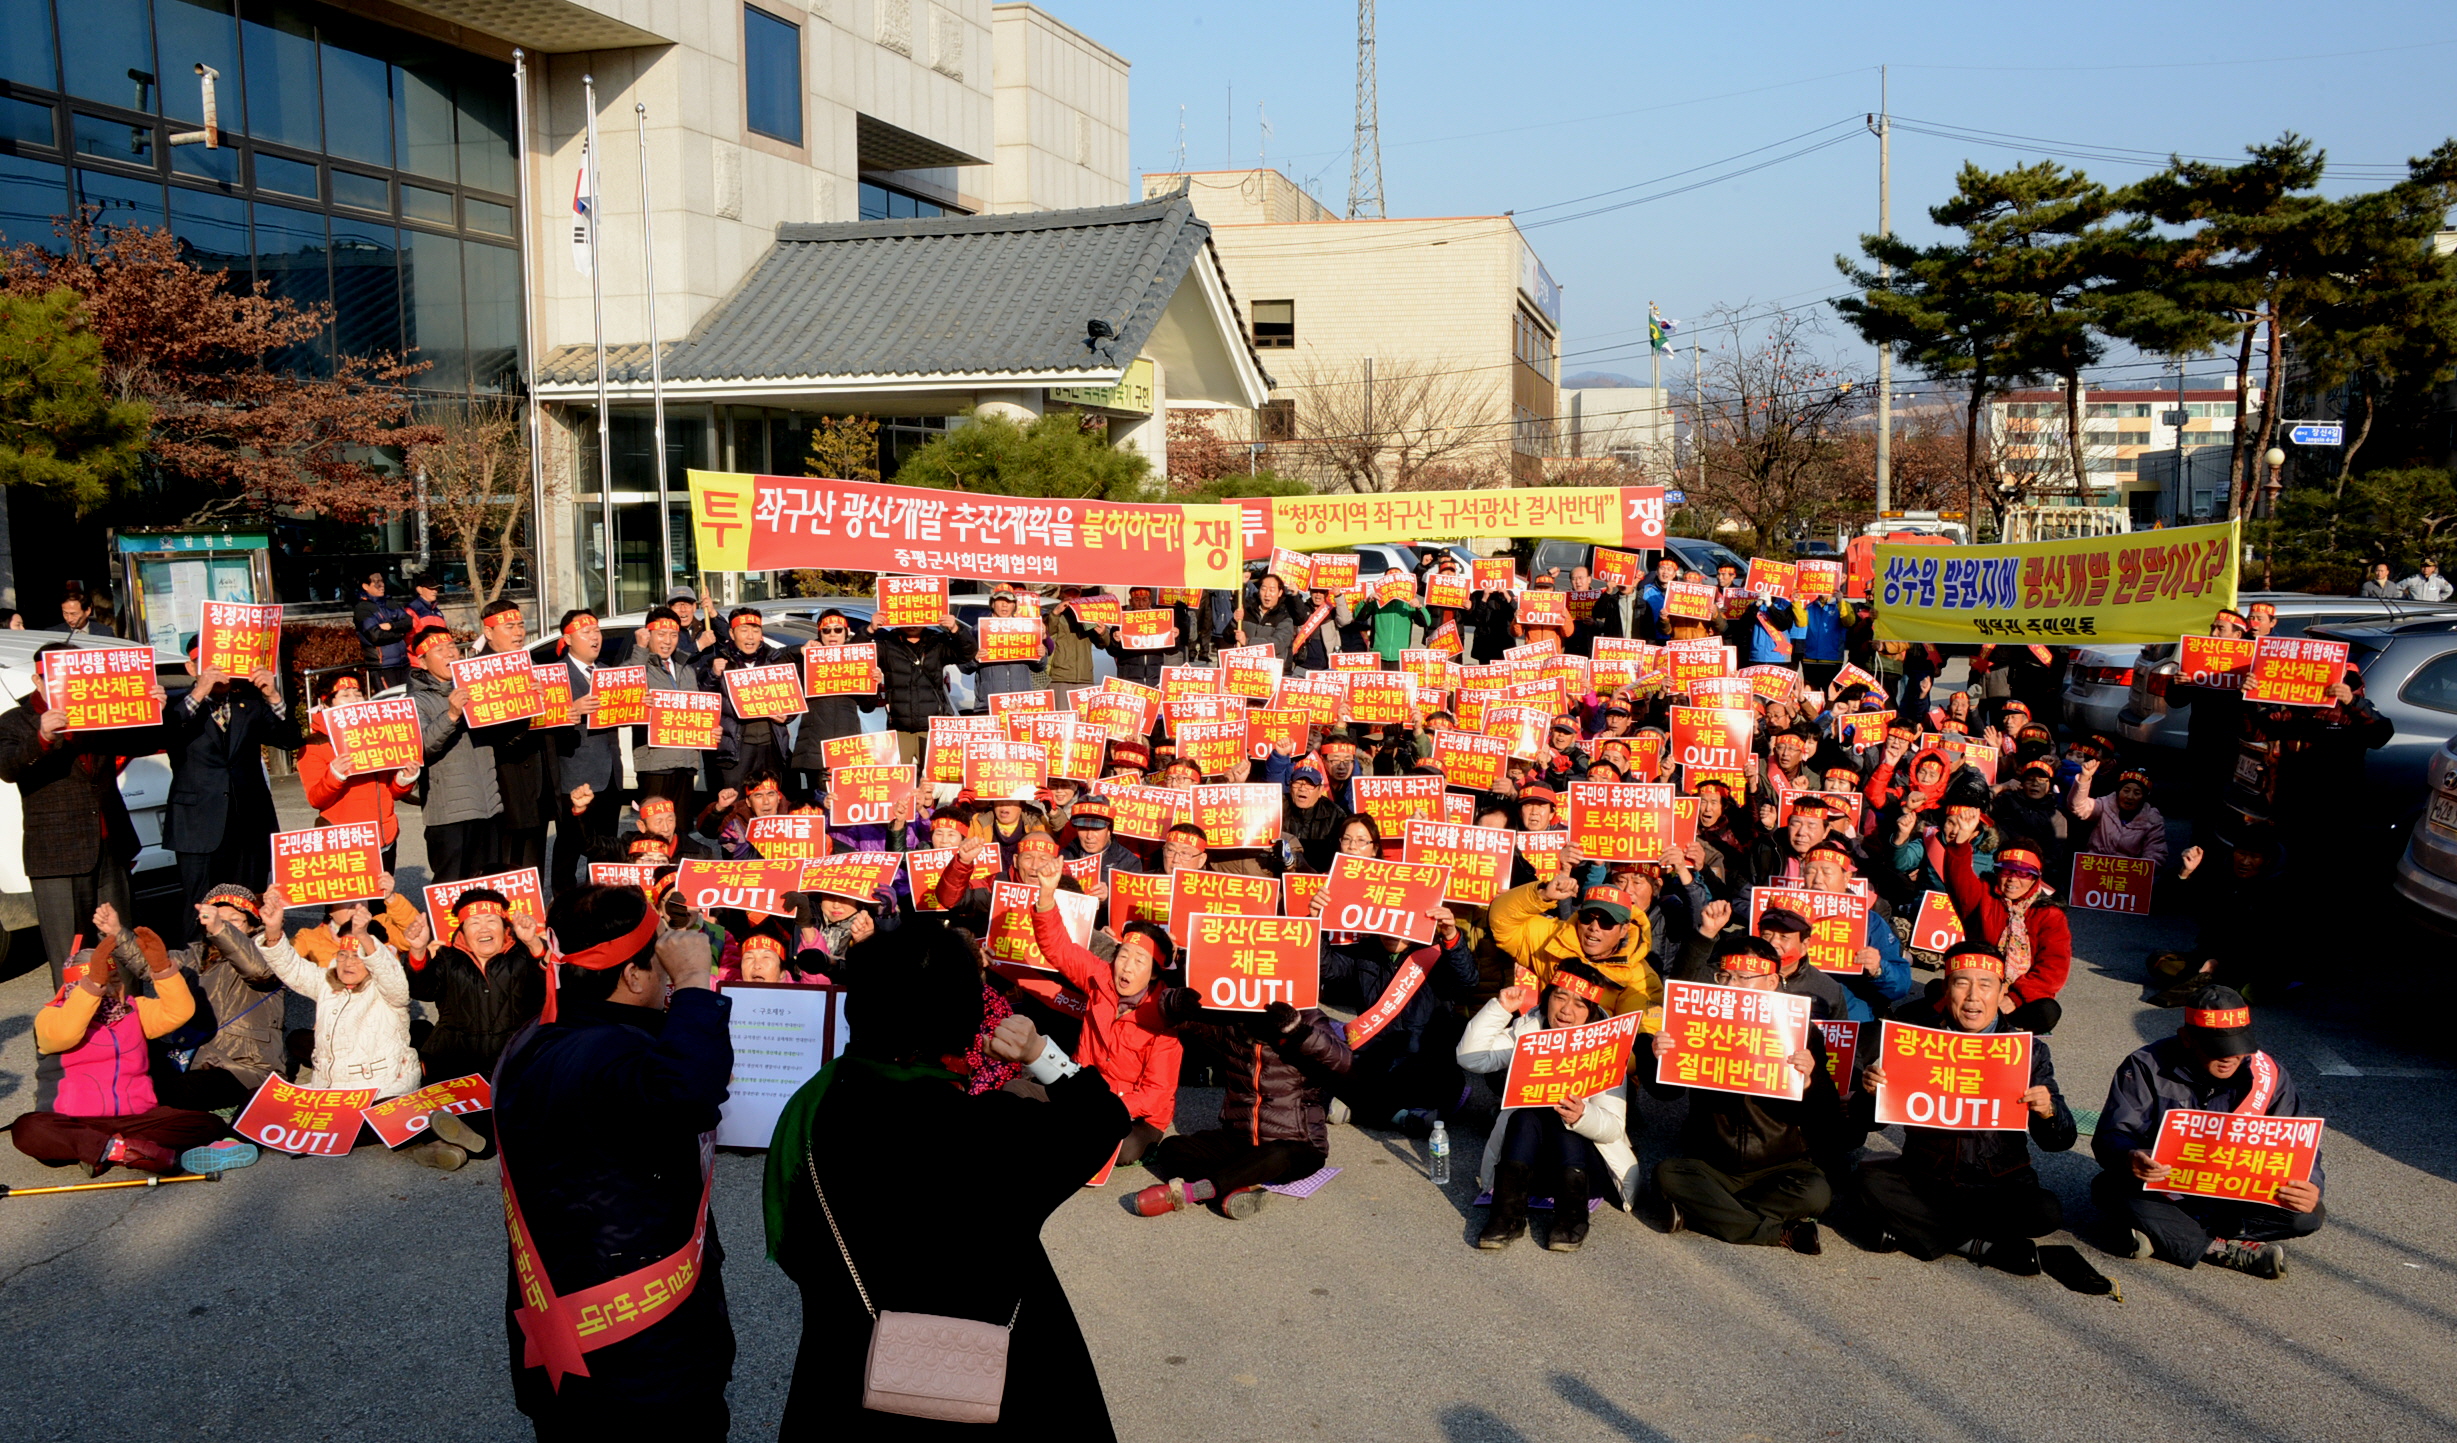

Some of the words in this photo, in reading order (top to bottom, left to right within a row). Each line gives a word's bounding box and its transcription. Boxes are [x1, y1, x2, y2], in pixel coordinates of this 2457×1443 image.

[700, 490, 743, 548] 투
[755, 488, 833, 535] 좌구산
[841, 494, 945, 542] 광산개발
[951, 505, 1074, 547] 추진계획을
[1079, 509, 1181, 552] 불허하라!
[1374, 501, 1434, 530] 좌구산
[1439, 499, 1520, 528] 규석광산
[1628, 498, 1663, 536] 쟁
[1193, 521, 1232, 571] 쟁
[894, 548, 1058, 576] 증평군사회단체협의회
[1476, 561, 1512, 570] 광산(토석)
[1598, 549, 1635, 564] 광산(토석)
[1319, 566, 1352, 577] 토석채취
[1486, 570, 1501, 579] 채굴
[1605, 562, 1622, 573] 채굴
[1754, 560, 1795, 575] 광산(토석)
[1802, 572, 1836, 583] 석산개발
[888, 579, 940, 593] 광산채굴
[1763, 573, 1782, 584] 채굴
[1801, 583, 1835, 593] 속지마라
[1883, 556, 1938, 607] 상수원
[1943, 556, 2019, 610] 발원지에
[2023, 549, 2111, 609] 광산개발
[886, 595, 942, 609] 절대반대!
[1522, 592, 1564, 603] 광산(토석)
[1534, 602, 1551, 612] 채굴
[1674, 593, 1708, 606] 토석채취
[210, 604, 262, 627] 청정지역
[886, 610, 942, 624] 절대반대!
[1124, 611, 1171, 623] 광산(토석)
[1138, 623, 1157, 634] 채굴
[2026, 617, 2095, 636] 주민일동
[986, 635, 1036, 647] 절대반대!
[2188, 637, 2254, 658] 광산(토석)
[2260, 639, 2300, 659] 군민생활
[2302, 640, 2345, 663] 위협하는
[51, 655, 105, 676] 군민생활
[108, 651, 152, 672] 위협하는
[809, 647, 842, 663] 군민생활
[843, 645, 874, 661] 위협하는
[987, 647, 1035, 660] 절대반대!
[1337, 654, 1374, 665] 광산채굴
[1677, 651, 1721, 664] 광산채굴
[2204, 655, 2233, 671] 채굴
[459, 661, 504, 682] 청정지역
[504, 655, 529, 672] 좌구산
[596, 673, 627, 688] 청정지역
[627, 669, 647, 684] 좌구산
[730, 669, 766, 686] 청정지역
[766, 666, 794, 681] 좌구산
[816, 664, 869, 678] 광산채굴
[1170, 670, 1214, 681] 광산채굴
[2263, 661, 2331, 683] 광산채굴
[67, 678, 146, 701] 광산채굴
[468, 677, 531, 702] 광산개발!
[814, 678, 871, 694] 절대반대!
[1167, 681, 1215, 695] 절대반대!
[1282, 680, 1310, 692] 군민생활
[1312, 682, 1342, 696] 위협하는
[1352, 674, 1384, 688] 청정지역
[1387, 674, 1416, 688] 좌구산
[1515, 679, 1557, 696] 광산채굴
[654, 692, 690, 709] 군민생활
[690, 695, 720, 710] 위협하는
[738, 684, 795, 701] 광산개발!
[1286, 694, 1334, 709] 광산채굴
[1353, 690, 1409, 704] 광산개발!
[66, 701, 152, 726] 절대반대!
[333, 708, 378, 730] 청정지역
[380, 703, 414, 721] 좌구산
[473, 696, 536, 723] 웬말이냐!
[596, 708, 644, 725] 웬말이냐!
[743, 700, 800, 716] 웬말이냐!
[1170, 703, 1217, 717] 광산채굴
[1352, 706, 1409, 721] 웬말이냐!
[661, 711, 715, 727] 광산채굴
[344, 724, 414, 748] 광산개발!
[1183, 727, 1219, 741] 청정지역
[1220, 723, 1245, 737] 좌구산
[1696, 729, 1727, 747] 채굴
[969, 743, 1006, 761] 군민생활
[1009, 745, 1045, 762] 위협하는
[1185, 740, 1241, 757] 광산개발!
[1439, 734, 1472, 750] 군민생활
[1474, 738, 1506, 755] 위협하는
[1443, 752, 1497, 770] 광산채굴
[1684, 746, 1736, 767] OUT!
[839, 766, 911, 785] 광산(토석)
[977, 762, 1038, 778] 광산채굴
[859, 786, 890, 801] 채굴
[1198, 786, 1241, 805] 청정지역
[1243, 786, 1278, 804] 좌구산
[1360, 779, 1403, 798] 청정지역
[1404, 777, 1440, 796] 좌구산
[1575, 785, 1609, 807] 국민의
[1611, 786, 1671, 808] 휴양단지에
[753, 818, 812, 839] 광산채굴
[1583, 810, 1659, 833] 토석채취
[278, 831, 325, 856] 군민생활
[326, 827, 375, 850] 위협하는
[1412, 824, 1460, 846] 군민생활
[1462, 829, 1511, 853] 위협하는
[1579, 834, 1663, 857] 웬말이냐!
[288, 851, 368, 879] 광산채굴
[691, 860, 797, 874] 광산(토석)
[1342, 858, 1442, 887] 광산(토석)
[2080, 855, 2150, 876] 광산(토석)
[287, 875, 375, 902] 절대반대!
[717, 873, 763, 887] 채굴
[1181, 873, 1272, 904] 광산(토석)
[2099, 875, 2128, 891] 채굴
[697, 888, 775, 911] OUT!
[1363, 884, 1406, 906] 채굴
[2085, 889, 2136, 912] OUT!
[1340, 903, 1415, 936] OUT!
[1200, 918, 1313, 947] 광산(토석)
[1230, 950, 1279, 976] 채굴
[1552, 970, 1599, 998] 결사반대
[1674, 986, 1738, 1017] 군민생활
[2203, 1010, 2249, 1027] 결사반
[1521, 1030, 1566, 1056] 국민의
[1569, 1014, 1635, 1051] 휴양단지에
[1683, 1021, 1785, 1058] 광산채굴
[1894, 1028, 2022, 1065] 광산(토석)
[1529, 1044, 1619, 1078] 토석채취
[1676, 1052, 1789, 1090] 절대반대!
[1519, 1068, 1615, 1103] 웬말이냐!
[1929, 1065, 1984, 1095] 채굴
[272, 1082, 370, 1109] 광산(토석)
[1906, 1091, 2000, 1127] OUT!
[288, 1109, 333, 1131] 채굴
[259, 1123, 339, 1153] OUT!
[2171, 1112, 2225, 1140] 국민의
[2227, 1117, 2317, 1149] 휴양단지에
[2177, 1143, 2294, 1177] 토석채취
